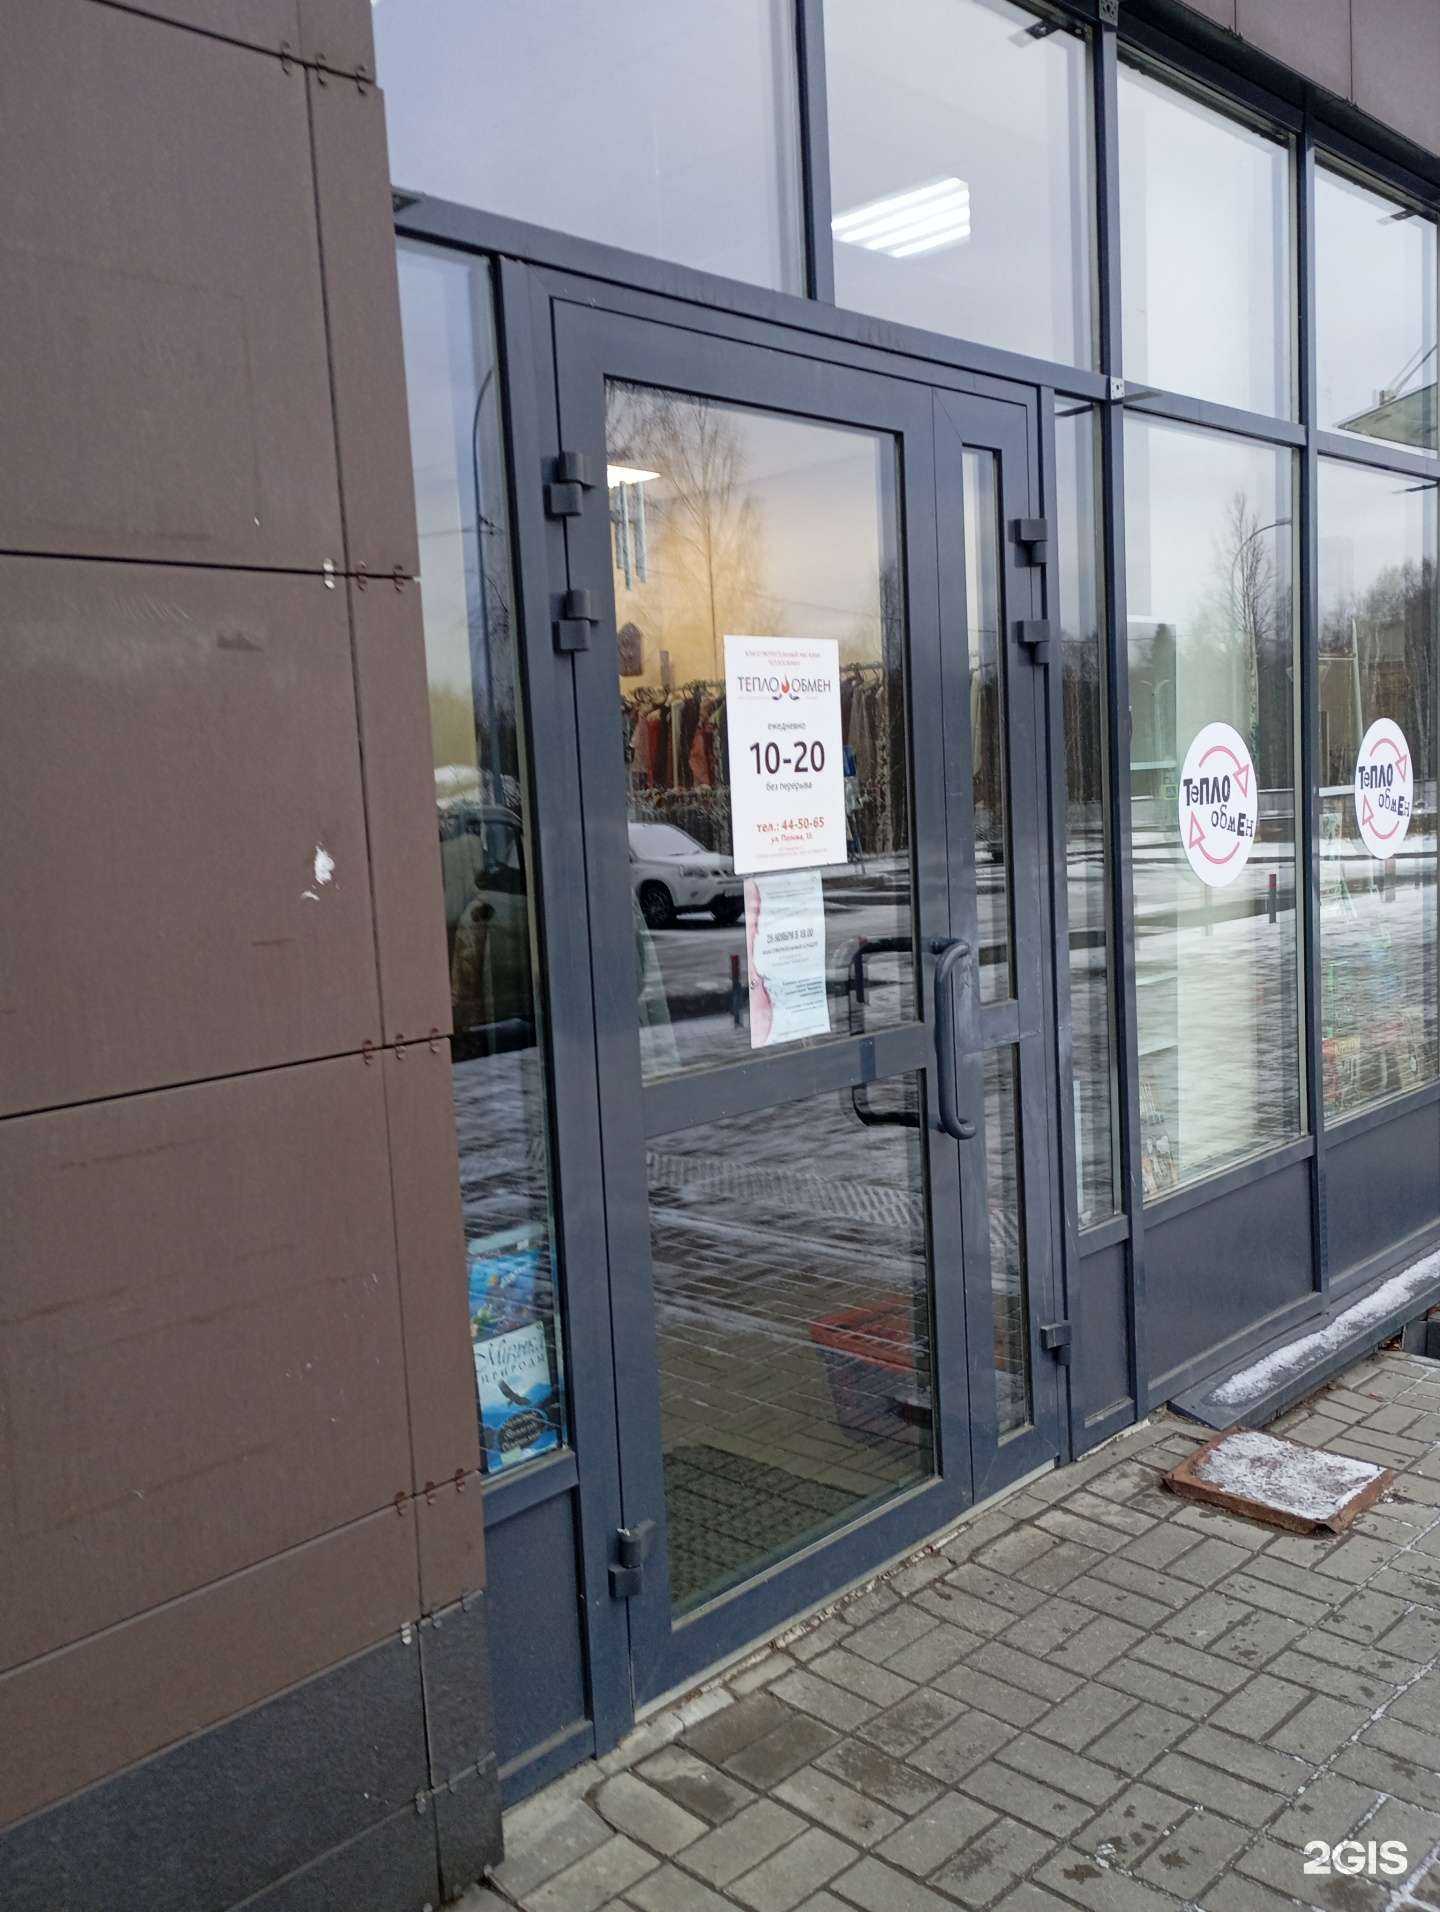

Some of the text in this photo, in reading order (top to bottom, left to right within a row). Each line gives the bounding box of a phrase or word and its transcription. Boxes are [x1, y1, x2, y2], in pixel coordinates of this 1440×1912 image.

[737, 676, 831, 693] ТЕПЛО ОБМЕН
[750, 740, 826, 774] 10-20
[782, 816, 826, 831] 44-50-65
